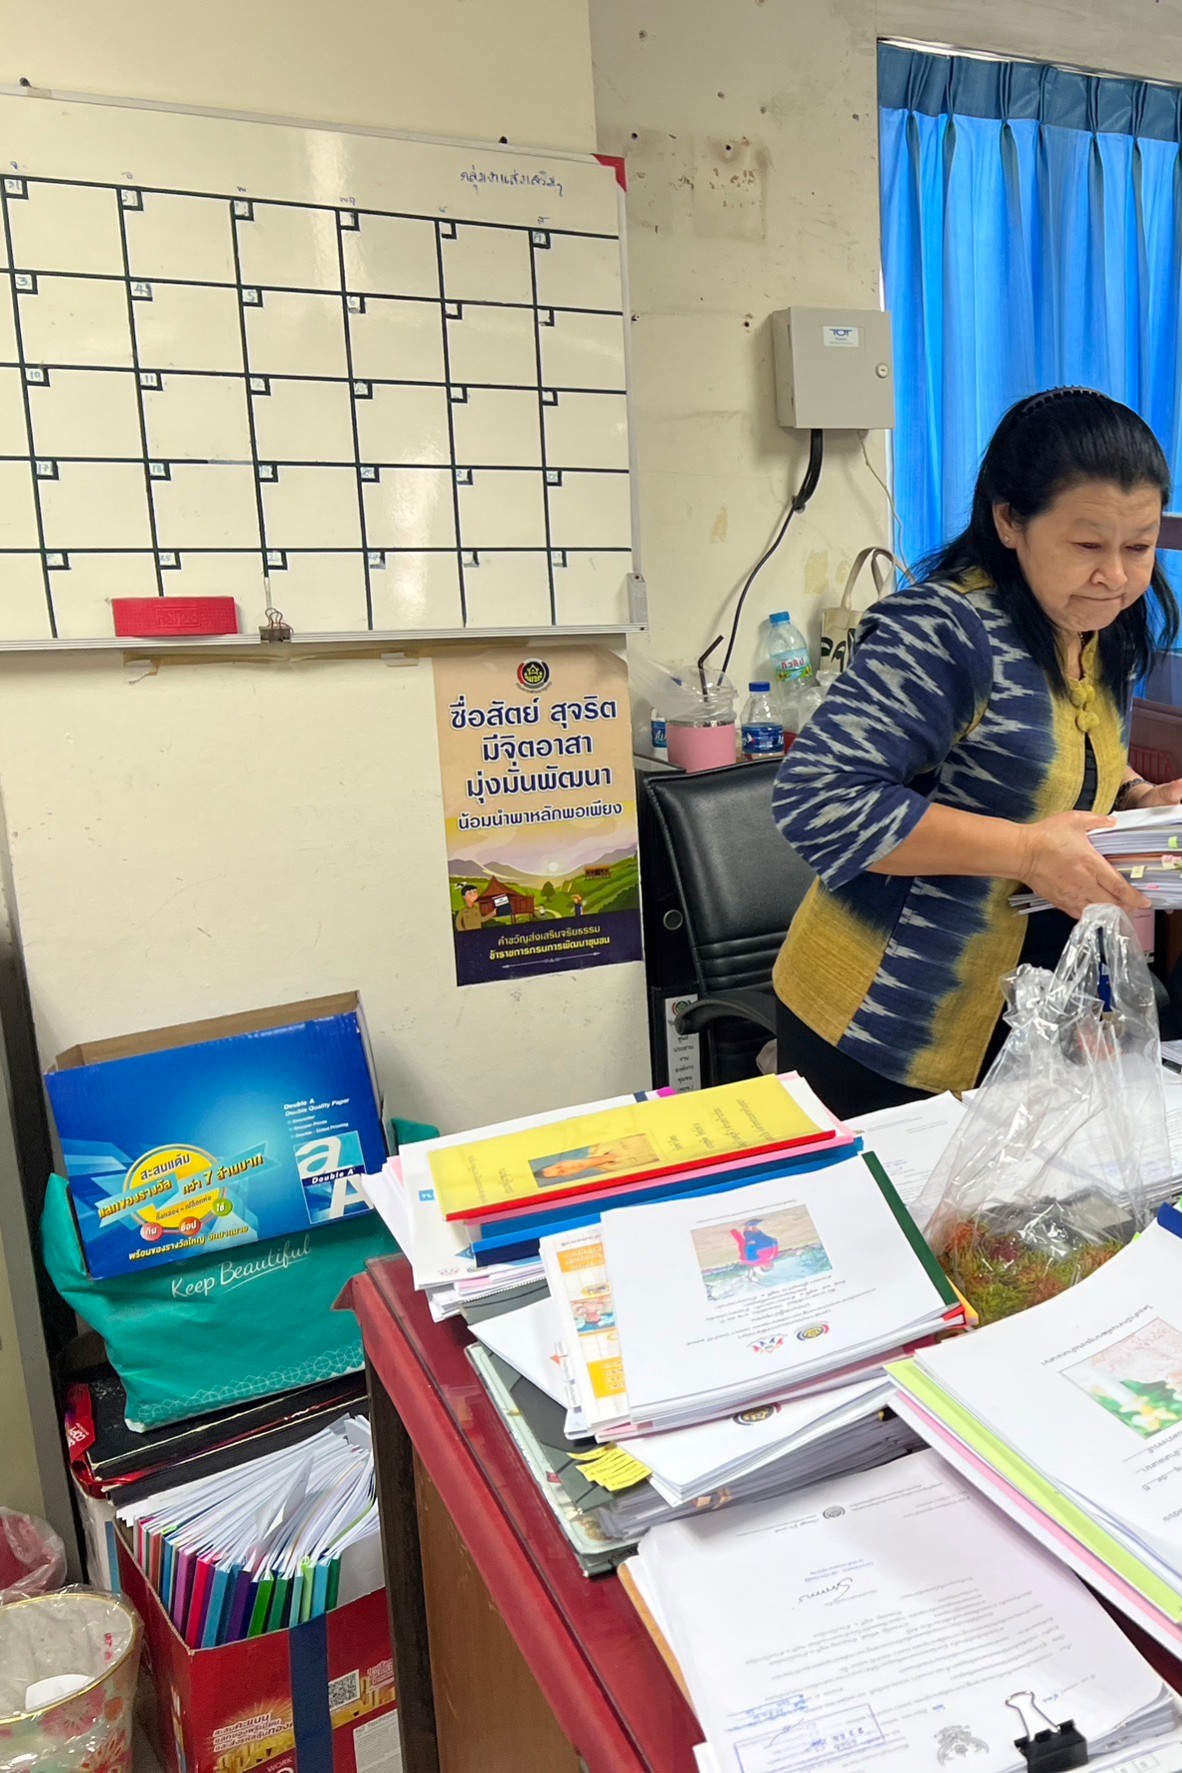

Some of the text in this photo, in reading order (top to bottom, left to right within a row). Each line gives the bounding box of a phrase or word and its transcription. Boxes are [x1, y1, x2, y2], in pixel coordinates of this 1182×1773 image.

[829, 328, 853, 337] TOT
[449, 694, 617, 730] ซื่อสัตย์ สุจริต
[482, 734, 592, 762] มีจิตอาสา
[466, 761, 612, 803] มุ่งมั่นพัฒนา
[458, 800, 623, 831] น้อมนำพาหลักพอเพียง
[489, 937, 611, 960] ข้าราชการกรมการพัฒนาชุมชน
[498, 926, 601, 946] คำขวัญส่งเสริมจริยธรรม
[283, 1100, 307, 1110] Double
[285, 1098, 350, 1116] Double Quality Paper
[141, 1153, 190, 1181] สะสมแต้ม
[312, 1171, 345, 1184] Double
[99, 1153, 265, 1219] แลกของรางวัล กว่า 7 ล้านบาท
[129, 1234, 206, 1261] พร้อมของรางวัลใหญ่
[171, 1234, 312, 1299] Keep Beautiful
[213, 1713, 270, 1737] สะสมคะแนน
